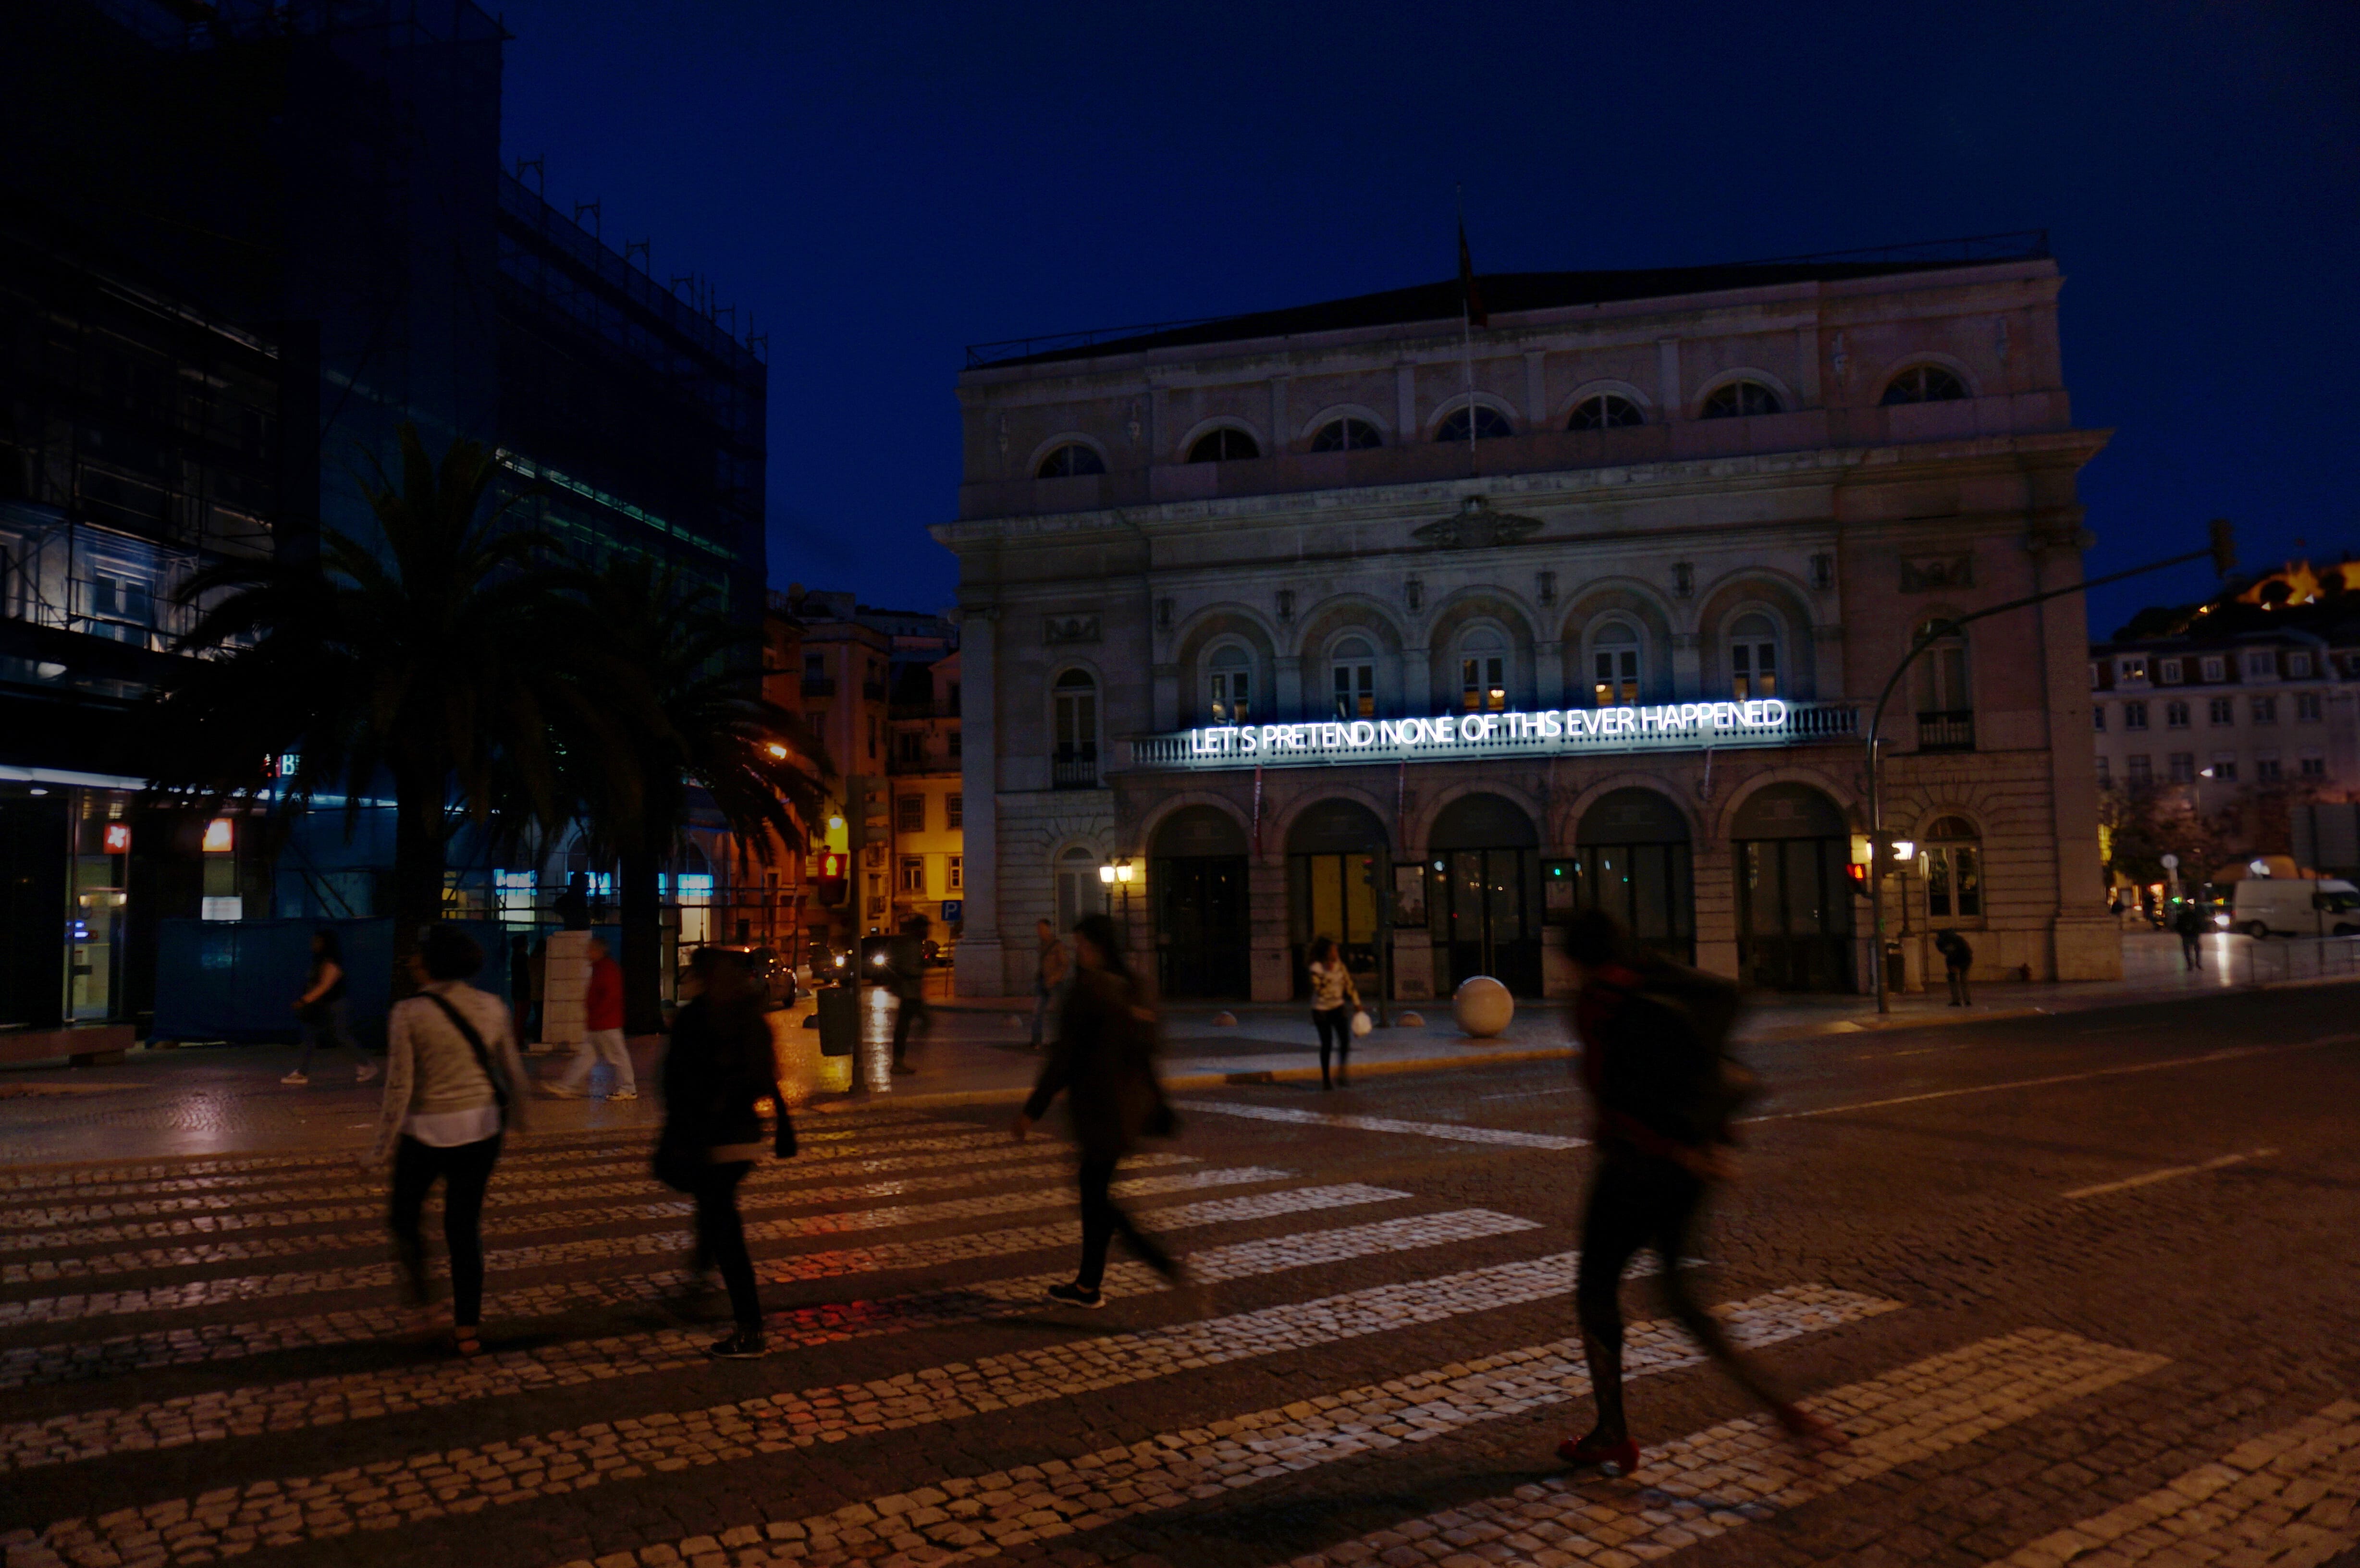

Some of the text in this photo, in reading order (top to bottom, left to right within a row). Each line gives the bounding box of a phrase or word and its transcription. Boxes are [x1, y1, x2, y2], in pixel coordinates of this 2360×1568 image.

[1192, 699, 1786, 753] LET'S PRETEND NONE OF THIS EVER HAPPENED
[945, 902, 958, 919] P
